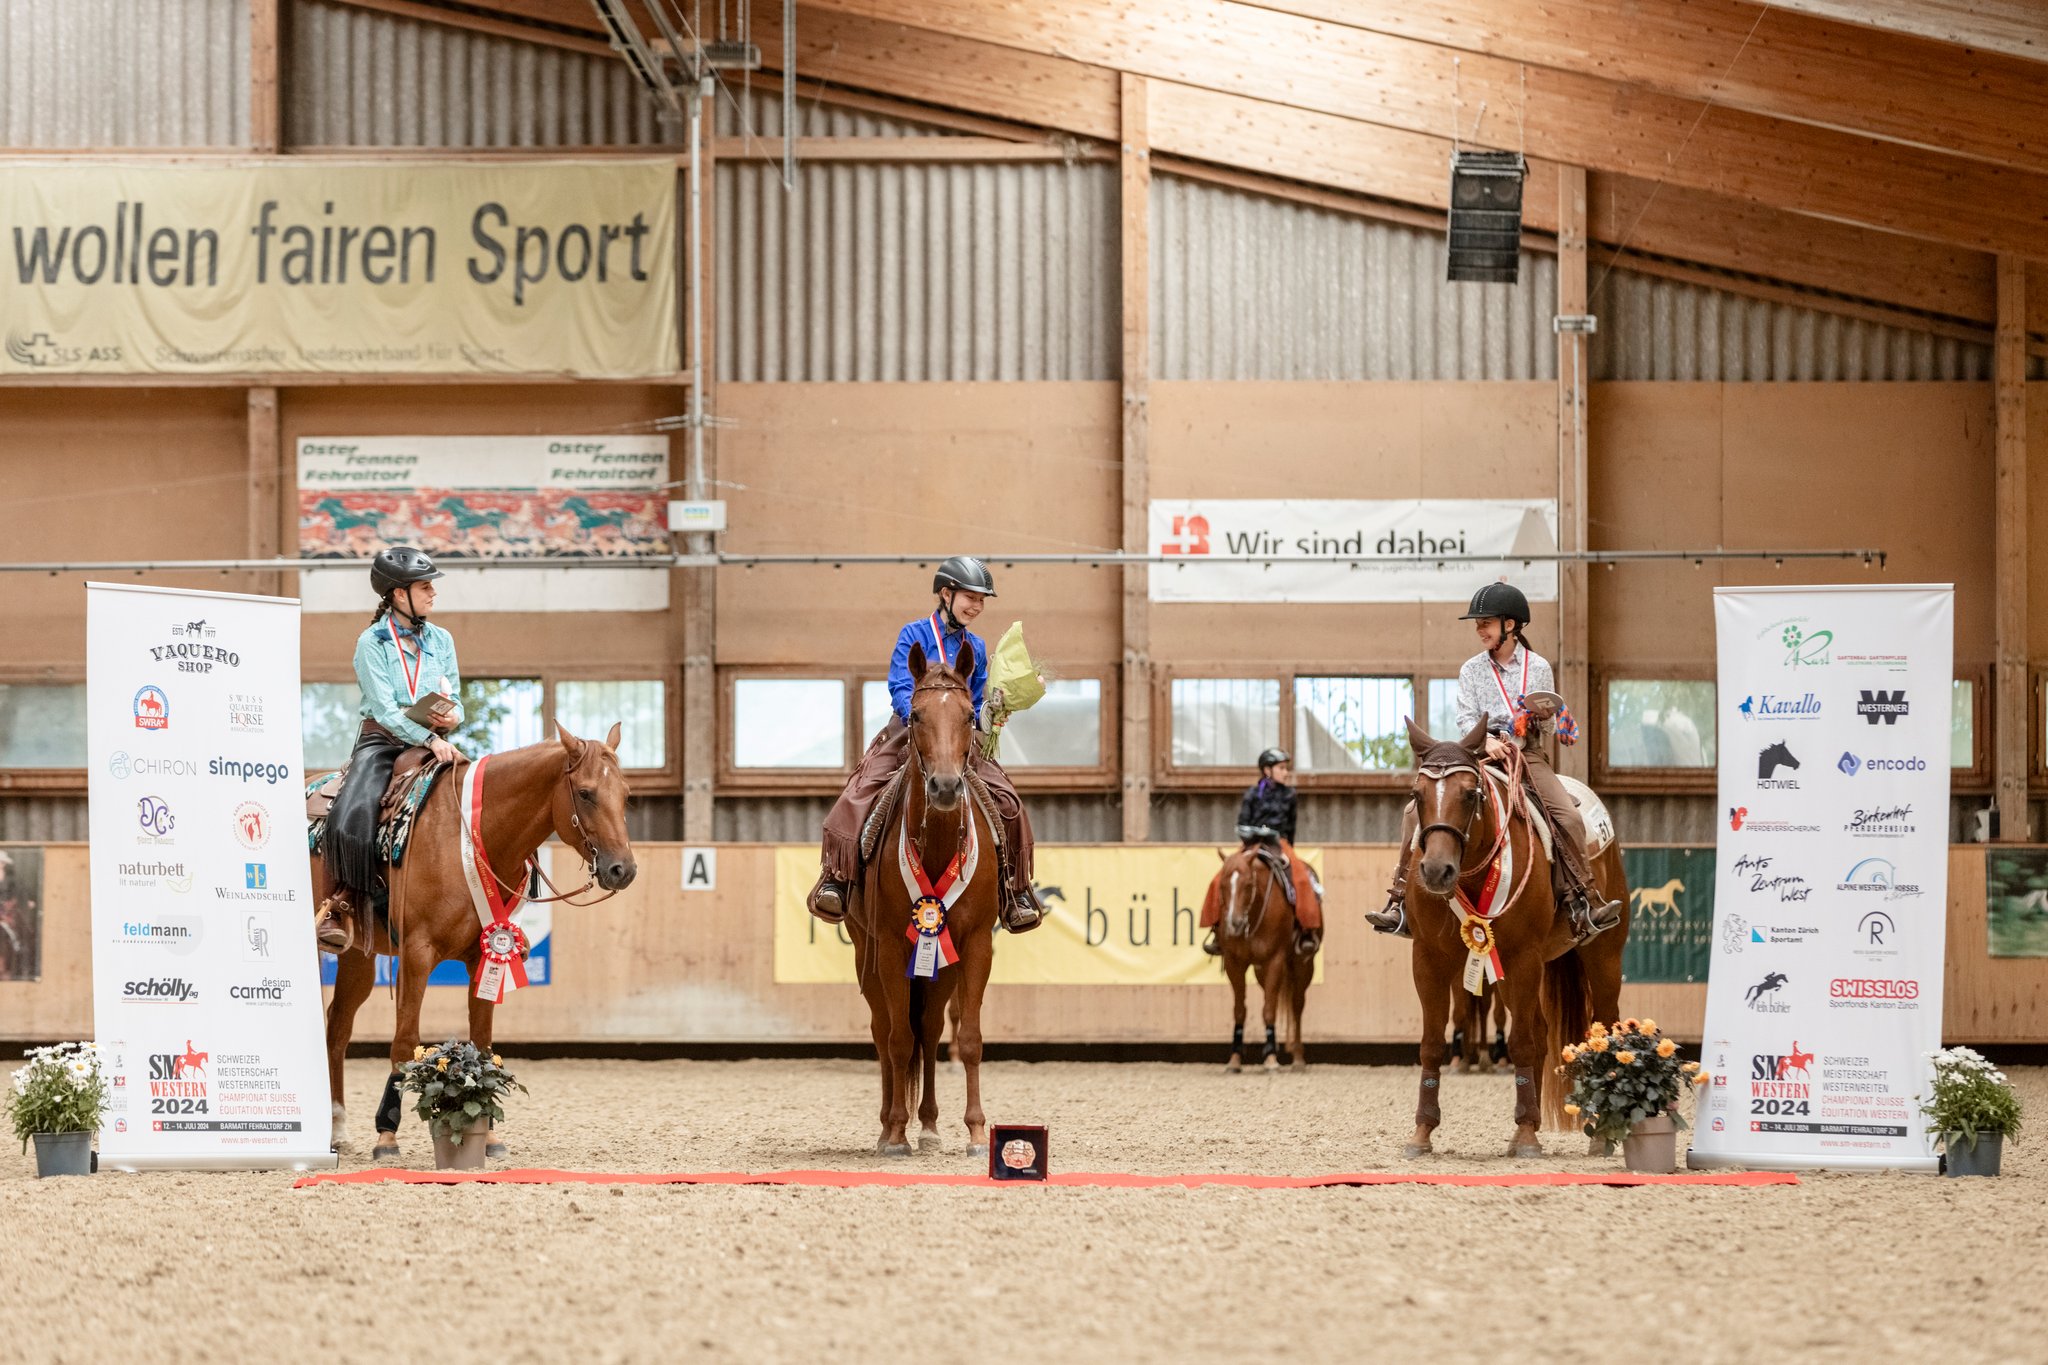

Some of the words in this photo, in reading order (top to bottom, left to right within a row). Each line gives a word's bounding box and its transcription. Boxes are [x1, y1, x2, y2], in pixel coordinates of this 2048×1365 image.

[12, 201, 219, 287] wollen
[251, 201, 436, 285] fairen
[467, 202, 650, 305] Sport
[302, 444, 359, 456] Oster
[549, 443, 606, 454] Oster
[346, 454, 419, 465] rennen
[592, 452, 664, 464] rennen
[1226, 530, 1283, 555] Wir
[1296, 530, 1362, 555] sind
[150, 643, 241, 668] VAQUERO
[177, 661, 213, 674] SHOP
[229, 703, 264, 712] QUARTER
[1758, 693, 1822, 714] Kavallo
[1858, 704, 1908, 713] WESTERNER
[134, 758, 197, 776] CHIRON
[1866, 756, 1926, 771] encodo
[208, 756, 289, 785] simpego
[1757, 780, 1800, 790] HOTWIEL
[118, 861, 184, 876] naturbett
[688, 854, 710, 885] A
[1732, 854, 1773, 876] Auto
[215, 887, 296, 902] WEINLANDSCHULE
[1087, 887, 1195, 947] büh
[1798, 926, 1820, 934] Zürich
[1870, 921, 1884, 944] R
[1770, 936, 1803, 944] Sportamt
[123, 977, 193, 1002] schölly
[262, 977, 292, 992] design
[1830, 978, 1919, 1000] SWISSLOS
[230, 986, 282, 1000] carma
[1830, 1000, 1868, 1009] Sportfonds
[1870, 1001, 1896, 1009] Kanton
[1898, 1001, 1919, 1010] Zürich
[217, 1055, 260, 1064] SCHWEIZER
[1823, 1056, 1870, 1067] SCHWEIZER
[150, 1054, 182, 1080] SM
[217, 1068, 278, 1078] MEISTERSCHAFT
[1752, 1054, 1786, 1081] SM
[1823, 1069, 1888, 1080] MEISTERSCHAFT
[150, 1081, 207, 1098] WESTERN
[218, 1080, 281, 1090] WESTERNREITEN
[1752, 1082, 1810, 1100] WESTERN
[1822, 1082, 1889, 1094] WESTERNREITEN
[218, 1092, 267, 1102] CHAMPIONAT
[270, 1094, 297, 1102] SUISSE
[1822, 1095, 1874, 1106] CHAMPIONAT
[1876, 1096, 1905, 1106] SUISSE
[152, 1098, 209, 1114] 2024
[266, 1106, 302, 1116] WESTERN
[1750, 1099, 1810, 1116] 2024
[1870, 1110, 1909, 1120] WESTERN
[184, 1122, 196, 1130] JULI
[197, 1122, 210, 1130] 2024
[220, 1122, 248, 1130] BARMATT
[248, 1122, 284, 1130] FEHRALTORF
[1784, 1124, 1796, 1132] JULI
[1820, 1125, 1849, 1133] BARMATT
[1850, 1126, 1888, 1134] FEHRALTORF
[220, 1136, 288, 1144] www.sm-western.ch
